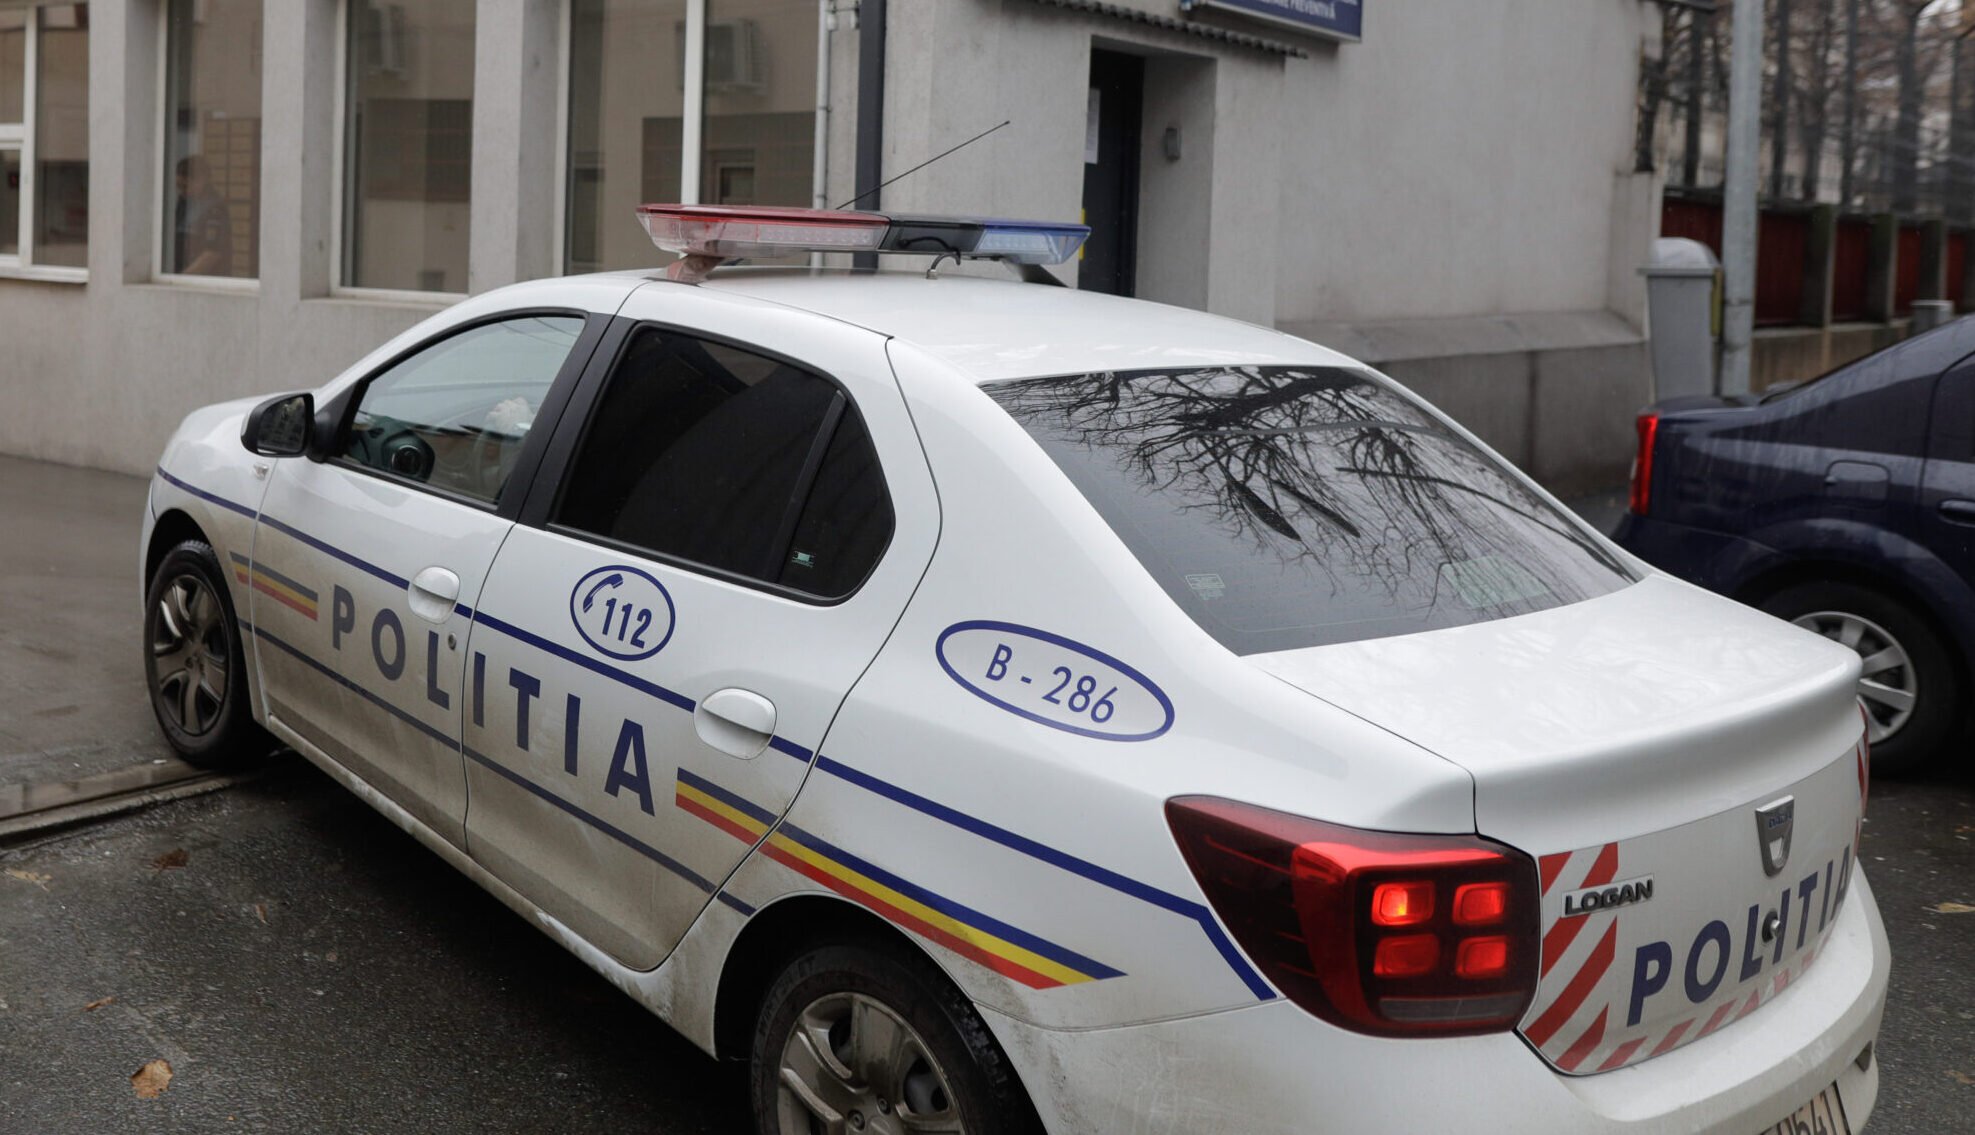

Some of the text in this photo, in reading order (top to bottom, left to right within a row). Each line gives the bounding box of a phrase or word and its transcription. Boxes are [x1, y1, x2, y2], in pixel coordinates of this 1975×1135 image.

[602, 598, 653, 650] 112
[332, 584, 655, 817] POLITIA
[1041, 666, 1118, 723] 286
[1564, 879, 1653, 916] LOGAN
[1626, 843, 1850, 1028] POLITIA
